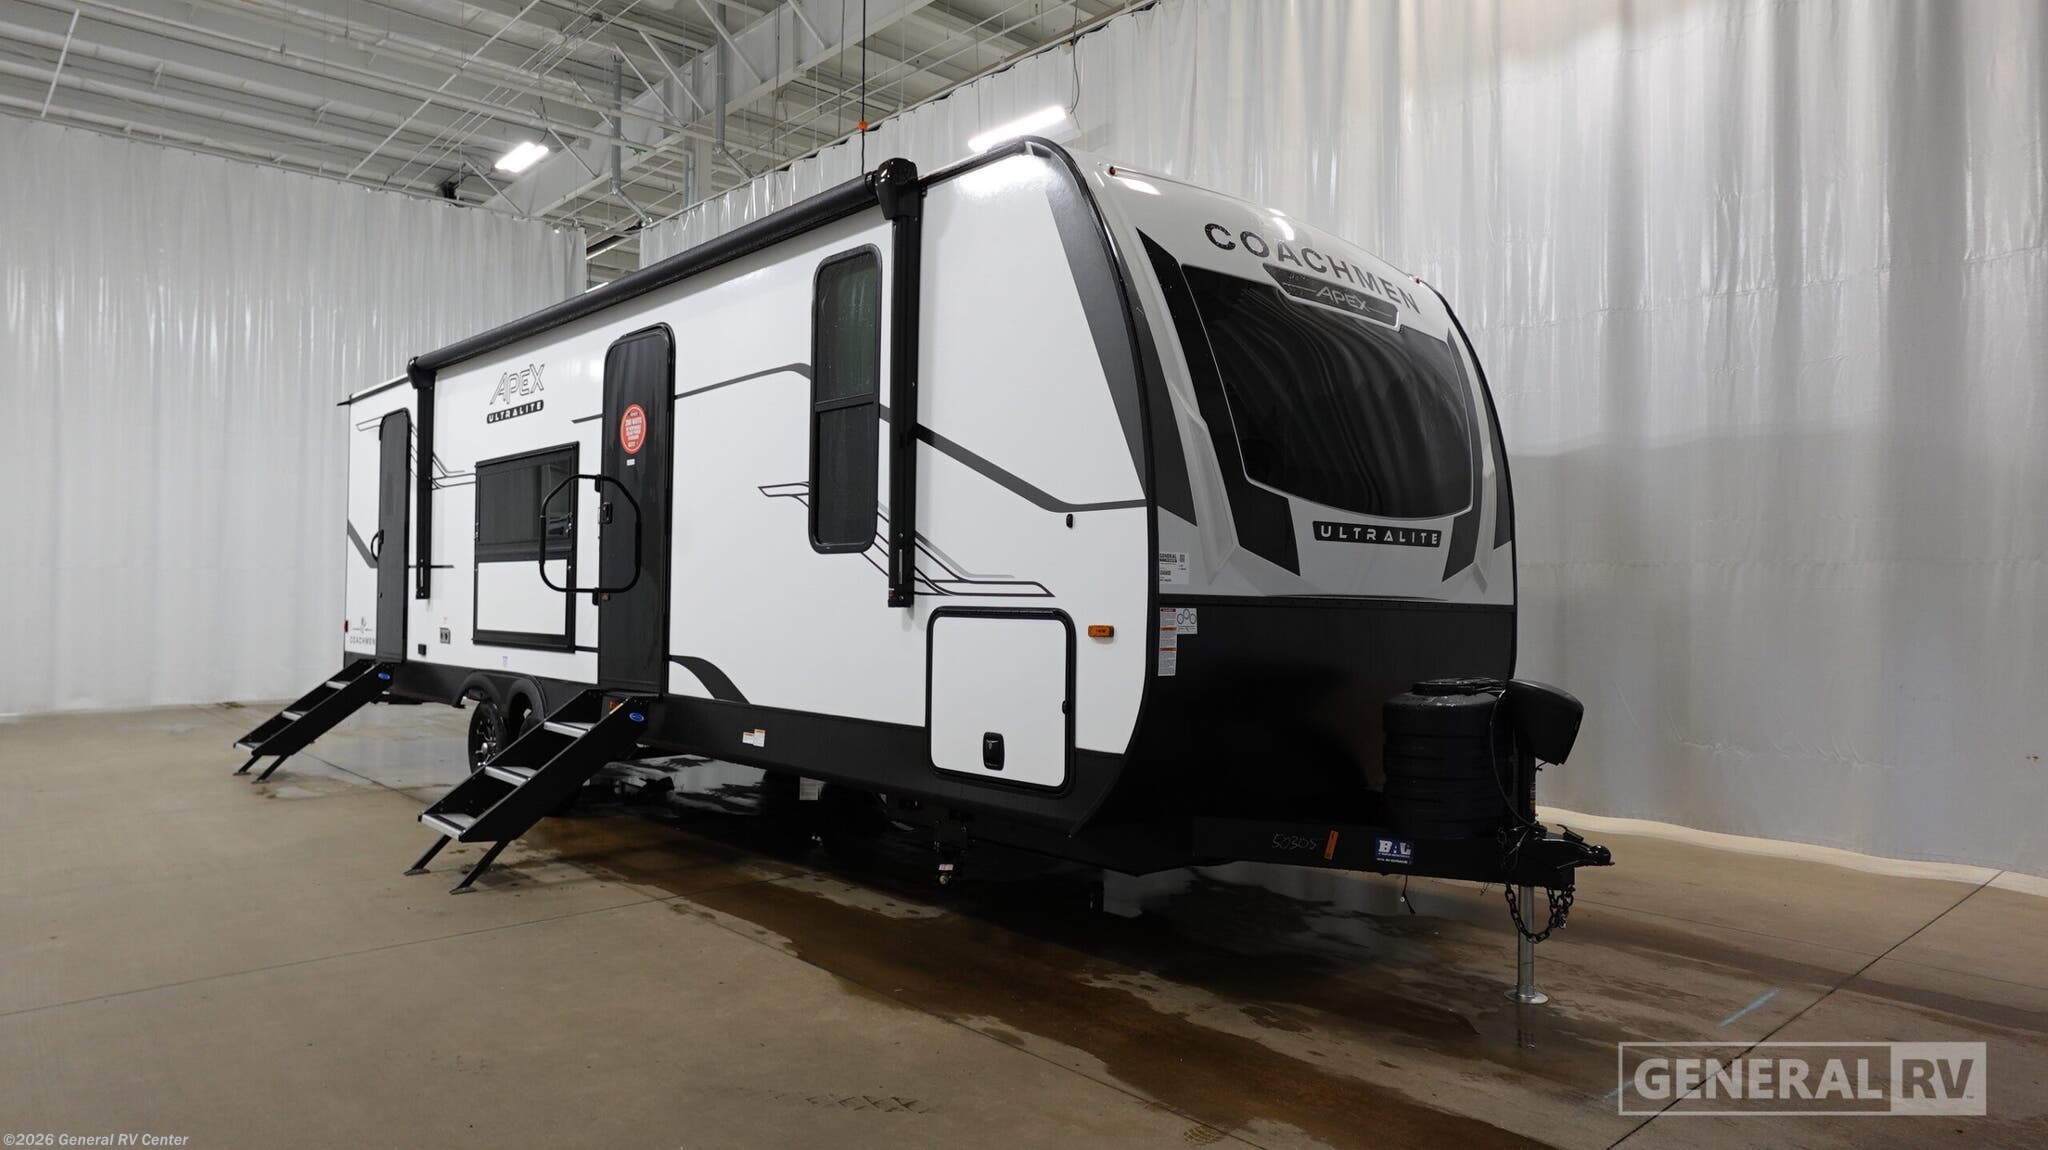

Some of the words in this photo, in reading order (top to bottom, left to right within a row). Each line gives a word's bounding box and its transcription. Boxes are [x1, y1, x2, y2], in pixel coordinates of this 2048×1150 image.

[1204, 222, 1421, 314] COACHMEN
[1316, 286, 1371, 312] APEX
[489, 363, 545, 406] APEX
[488, 401, 543, 422] ULTRALITE
[1320, 524, 1439, 545] ULTRALITE
